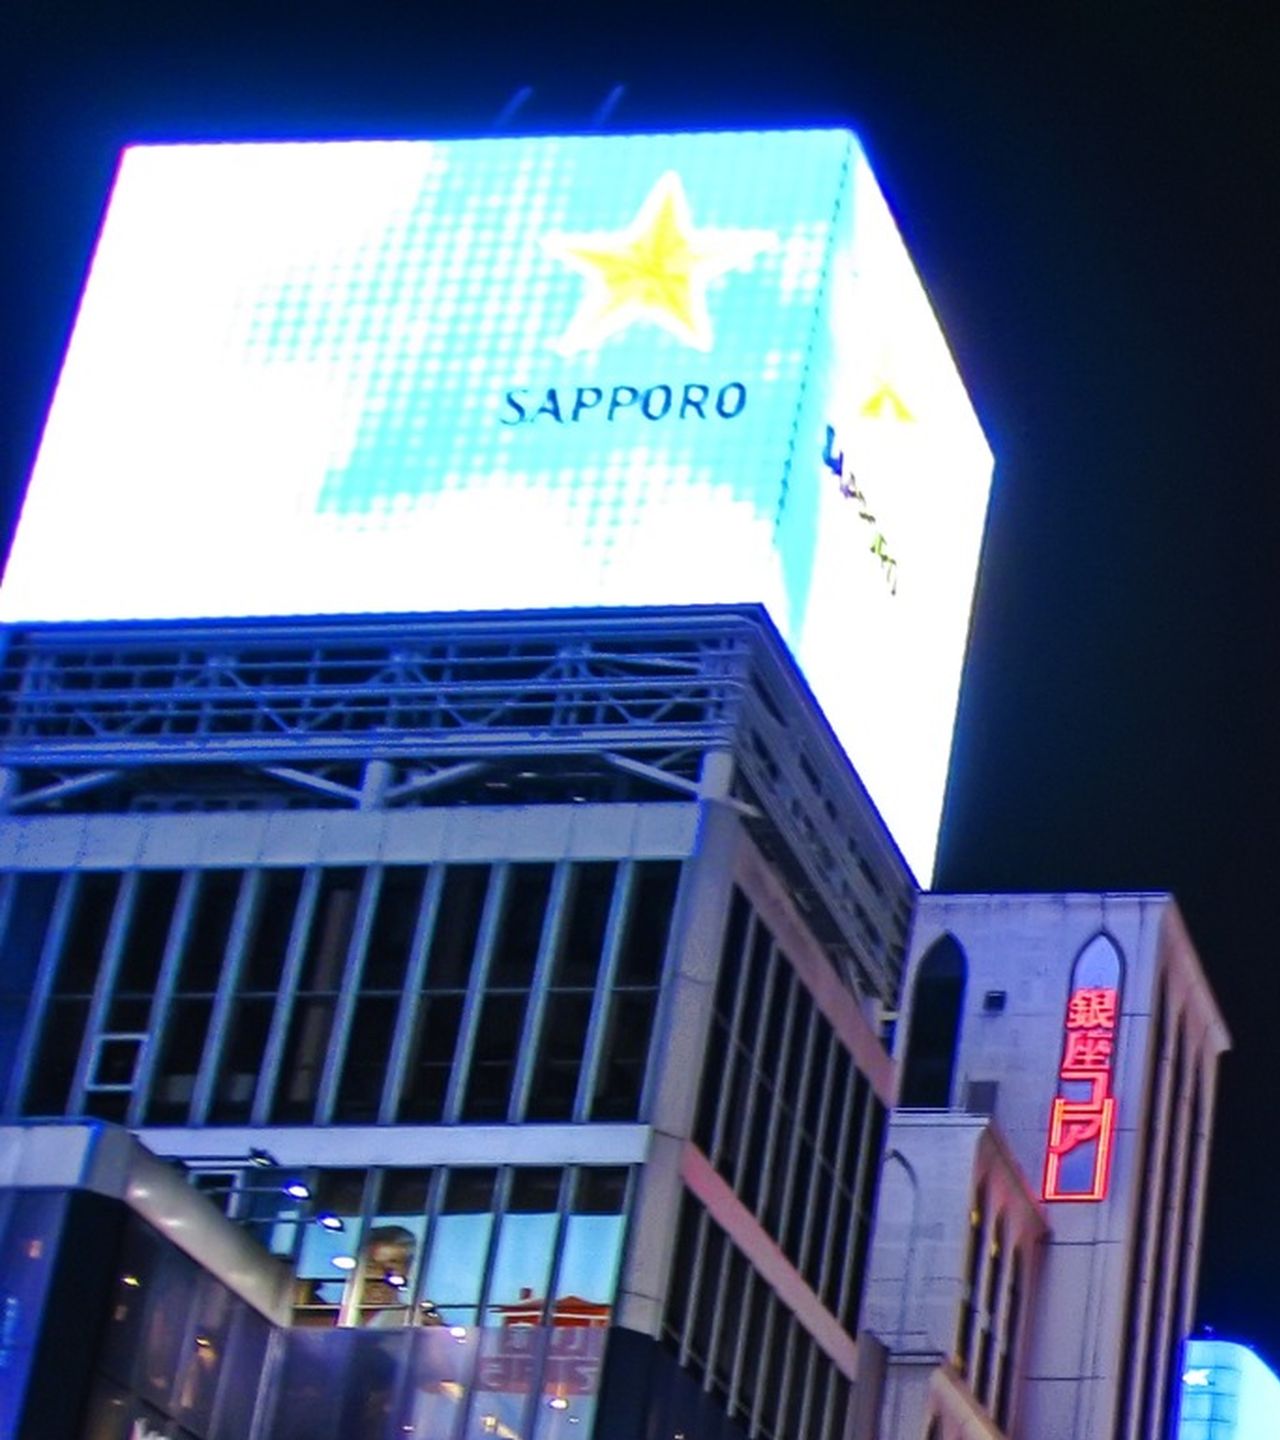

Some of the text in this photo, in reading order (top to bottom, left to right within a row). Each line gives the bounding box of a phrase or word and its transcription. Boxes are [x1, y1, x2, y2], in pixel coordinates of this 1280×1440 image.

[501, 380, 747, 427] SAPPORO
[1048, 987, 1118, 1155] 銀座コア
